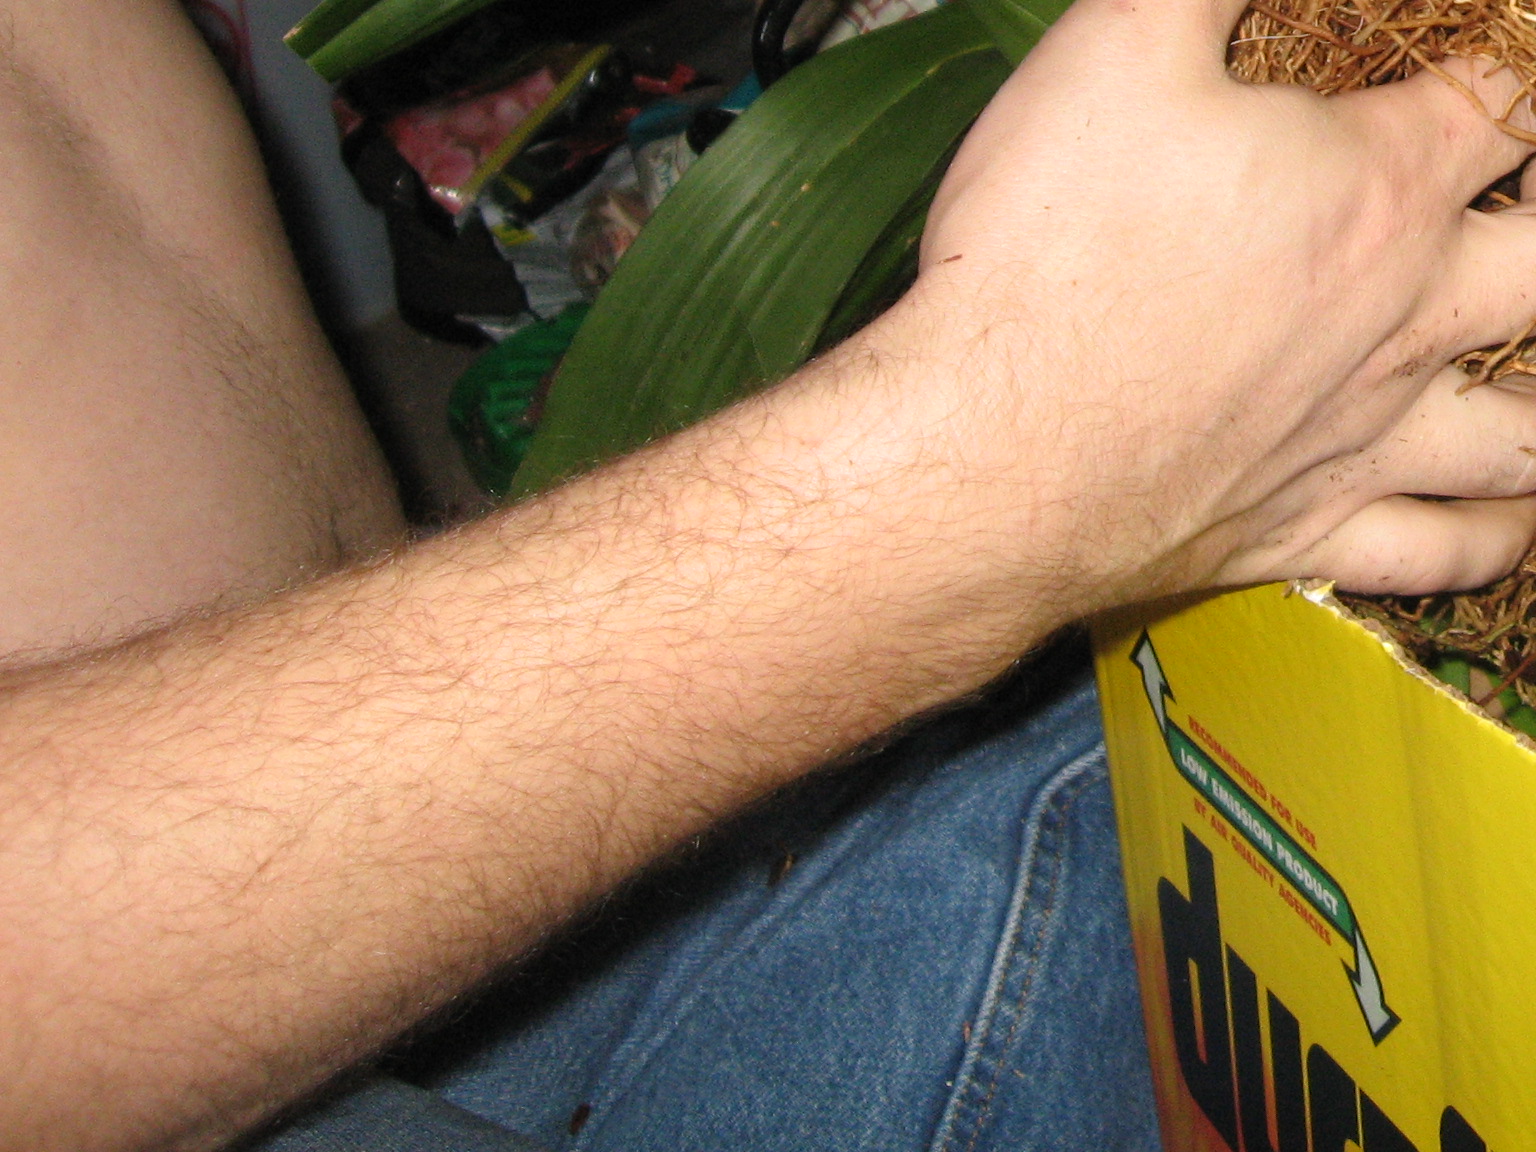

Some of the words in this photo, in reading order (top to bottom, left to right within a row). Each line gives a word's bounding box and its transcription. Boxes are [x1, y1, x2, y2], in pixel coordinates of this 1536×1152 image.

[1180, 747, 1208, 787] LOW
[1211, 777, 1274, 851] EMISSION
[1276, 841, 1339, 917] PRODUCT
[1210, 814, 1229, 841] AIR
[1230, 835, 1275, 889] QUALITY
[1278, 882, 1332, 947] AGENCIES
[1269, 793, 1293, 828] FOR
[1295, 818, 1317, 852] USE
